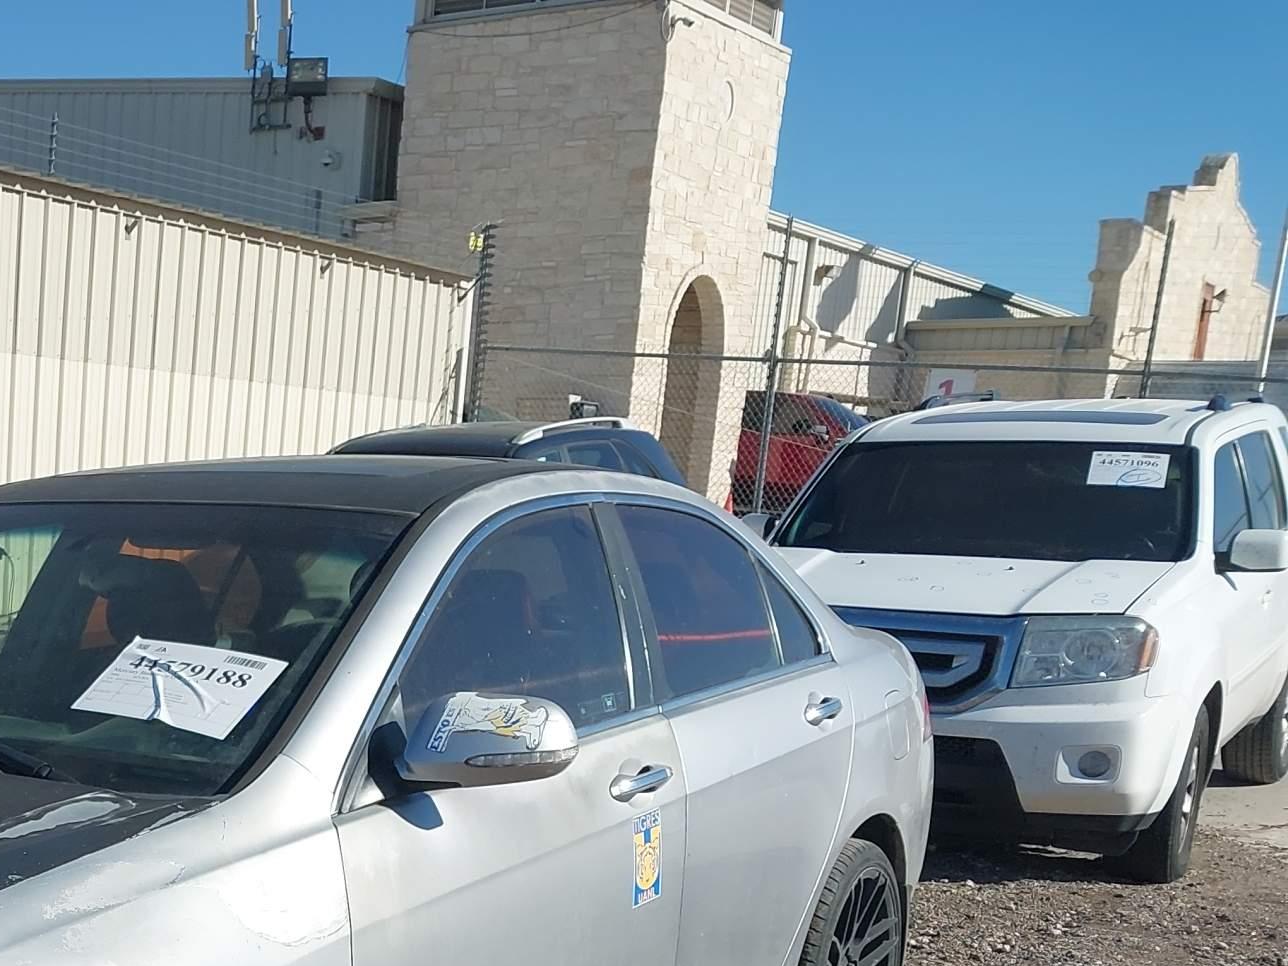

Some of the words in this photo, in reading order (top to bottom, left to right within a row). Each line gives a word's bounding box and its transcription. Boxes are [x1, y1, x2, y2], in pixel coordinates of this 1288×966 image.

[938, 378, 954, 396] 1
[429, 718, 451, 752] ESTO
[634, 811, 660, 833] TIGRES
[638, 887, 655, 904] UANL
